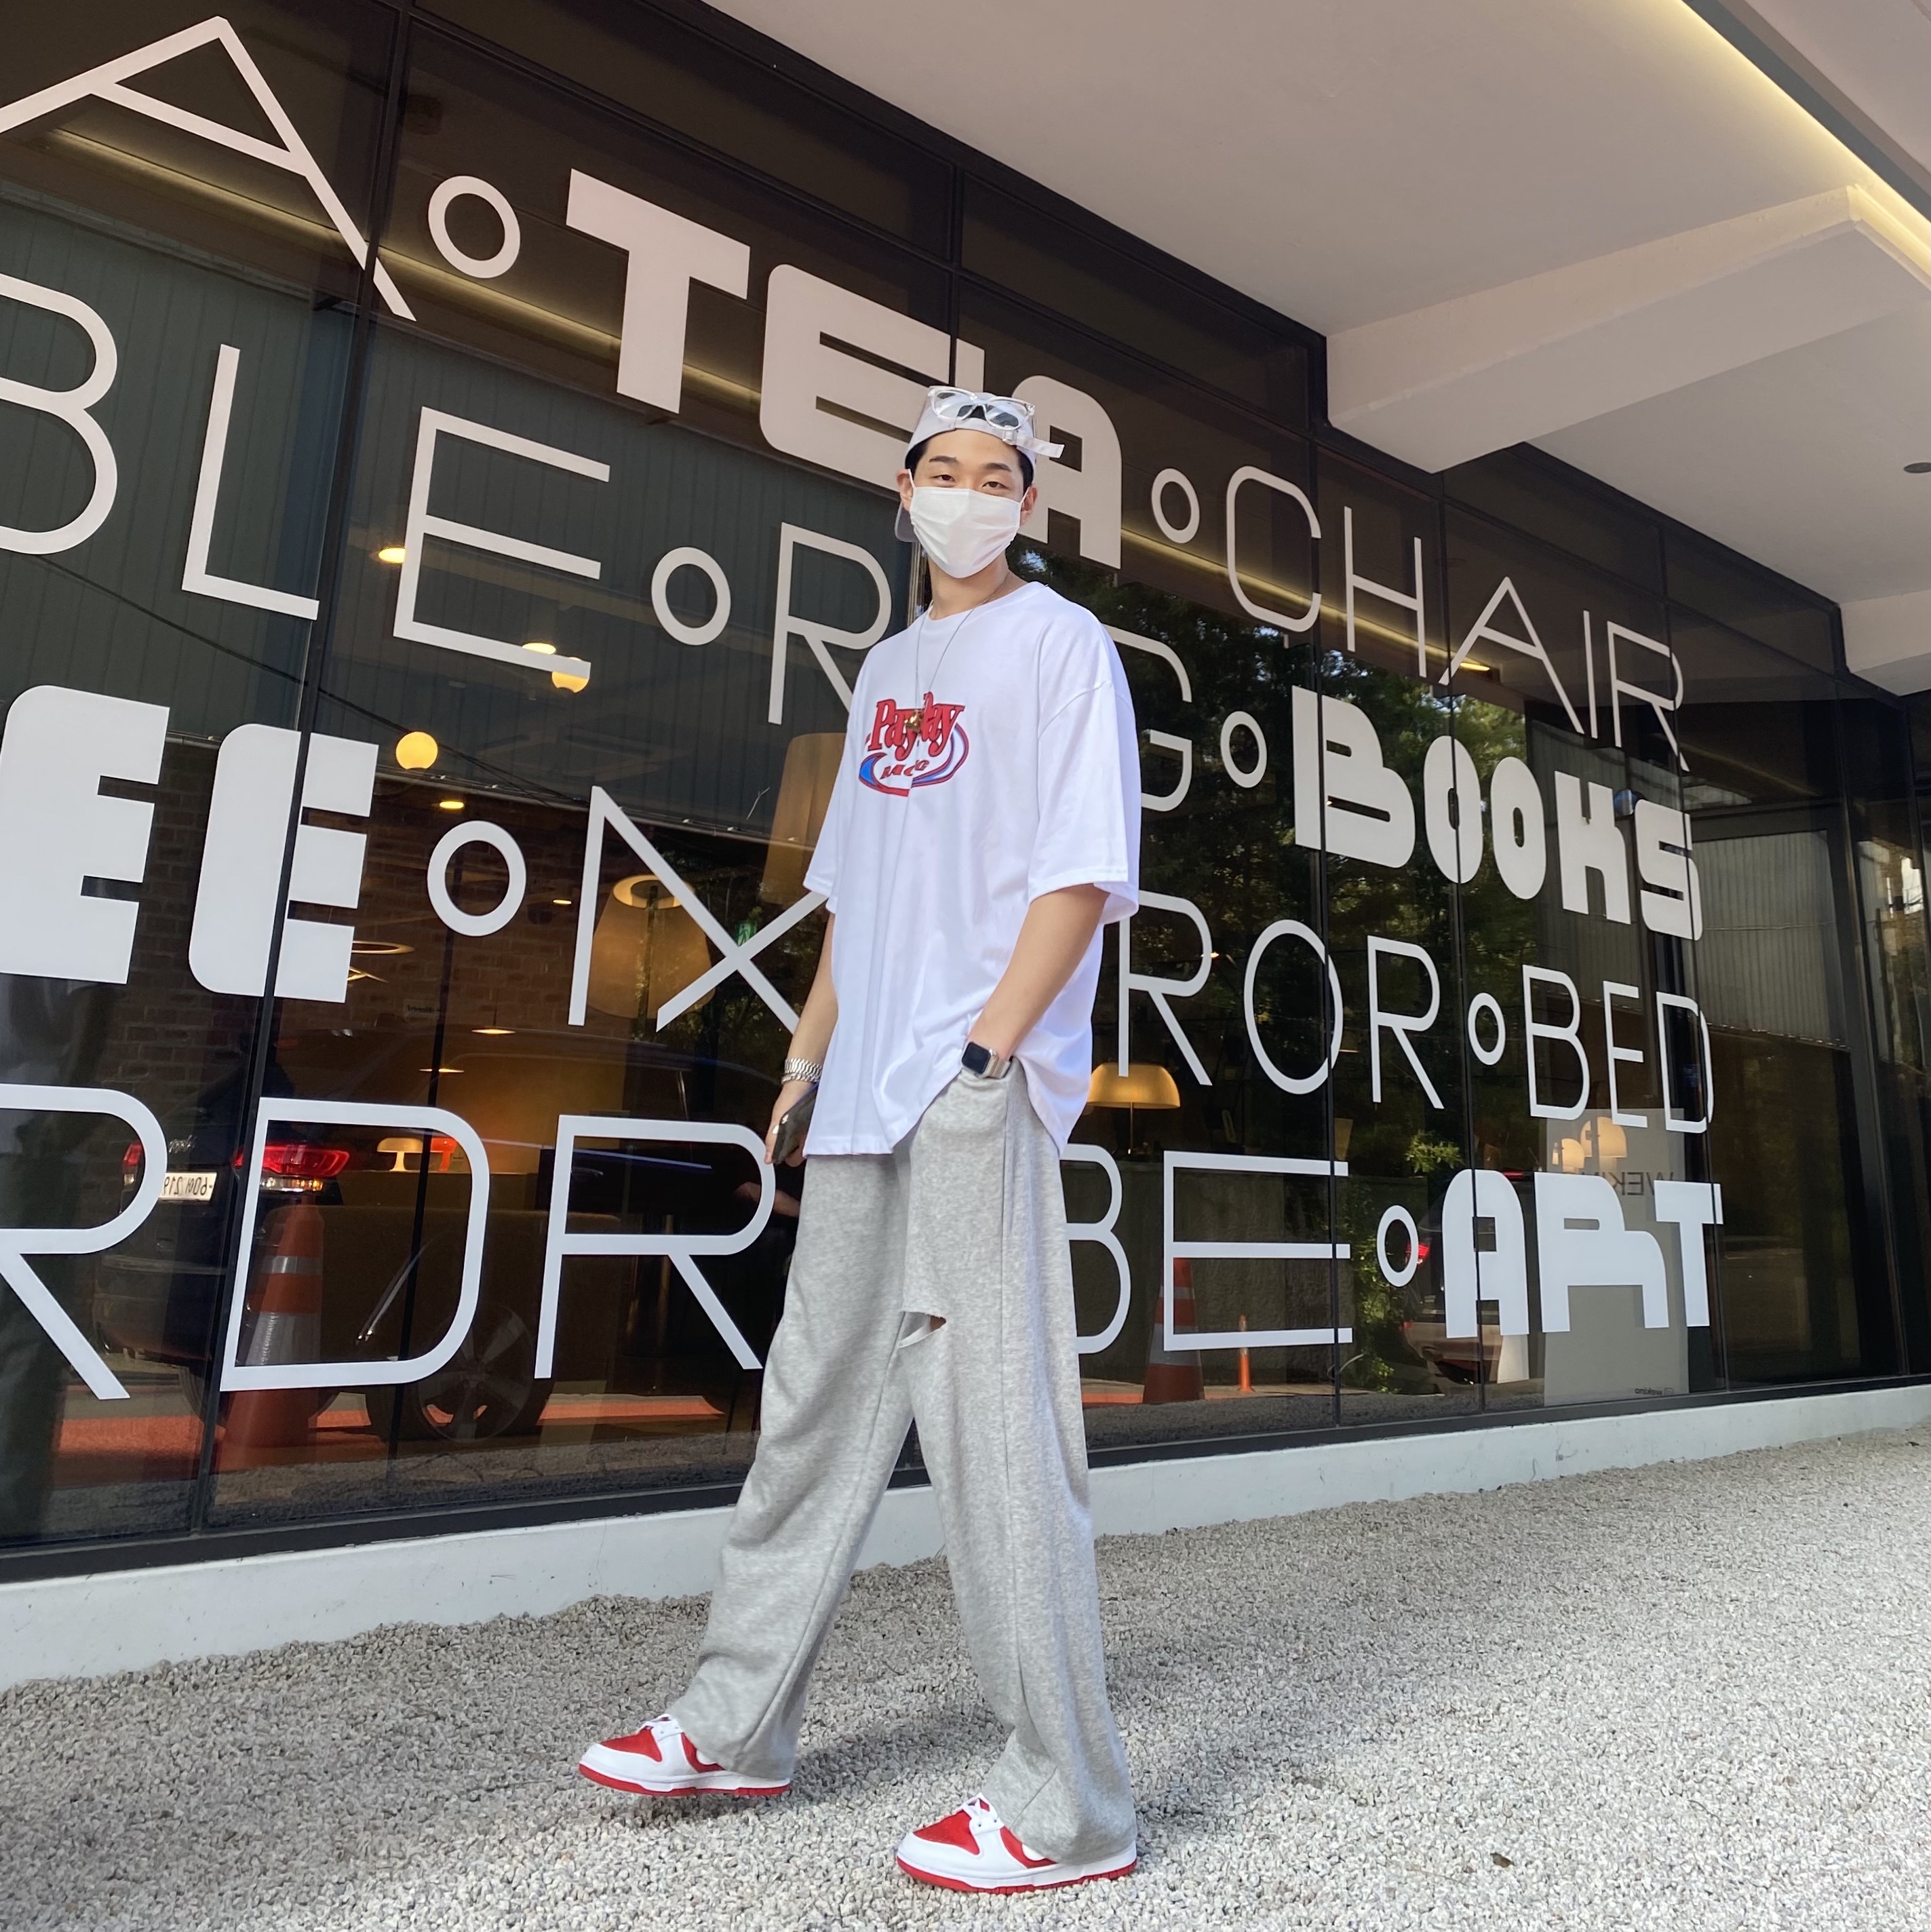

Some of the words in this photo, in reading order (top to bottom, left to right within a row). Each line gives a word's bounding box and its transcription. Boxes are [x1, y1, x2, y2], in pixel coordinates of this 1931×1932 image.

[566, 168, 1123, 570] TEA
[1226, 465, 1690, 772] CHAIR
[767, 521, 1193, 812] RG
[1291, 685, 1703, 941] BOOKS
[568, 786, 1445, 1109] MROR
[1522, 964, 1715, 1134] BED
[0, 1083, 1353, 1400] RDRBE
[1441, 1169, 1724, 1338] ART
